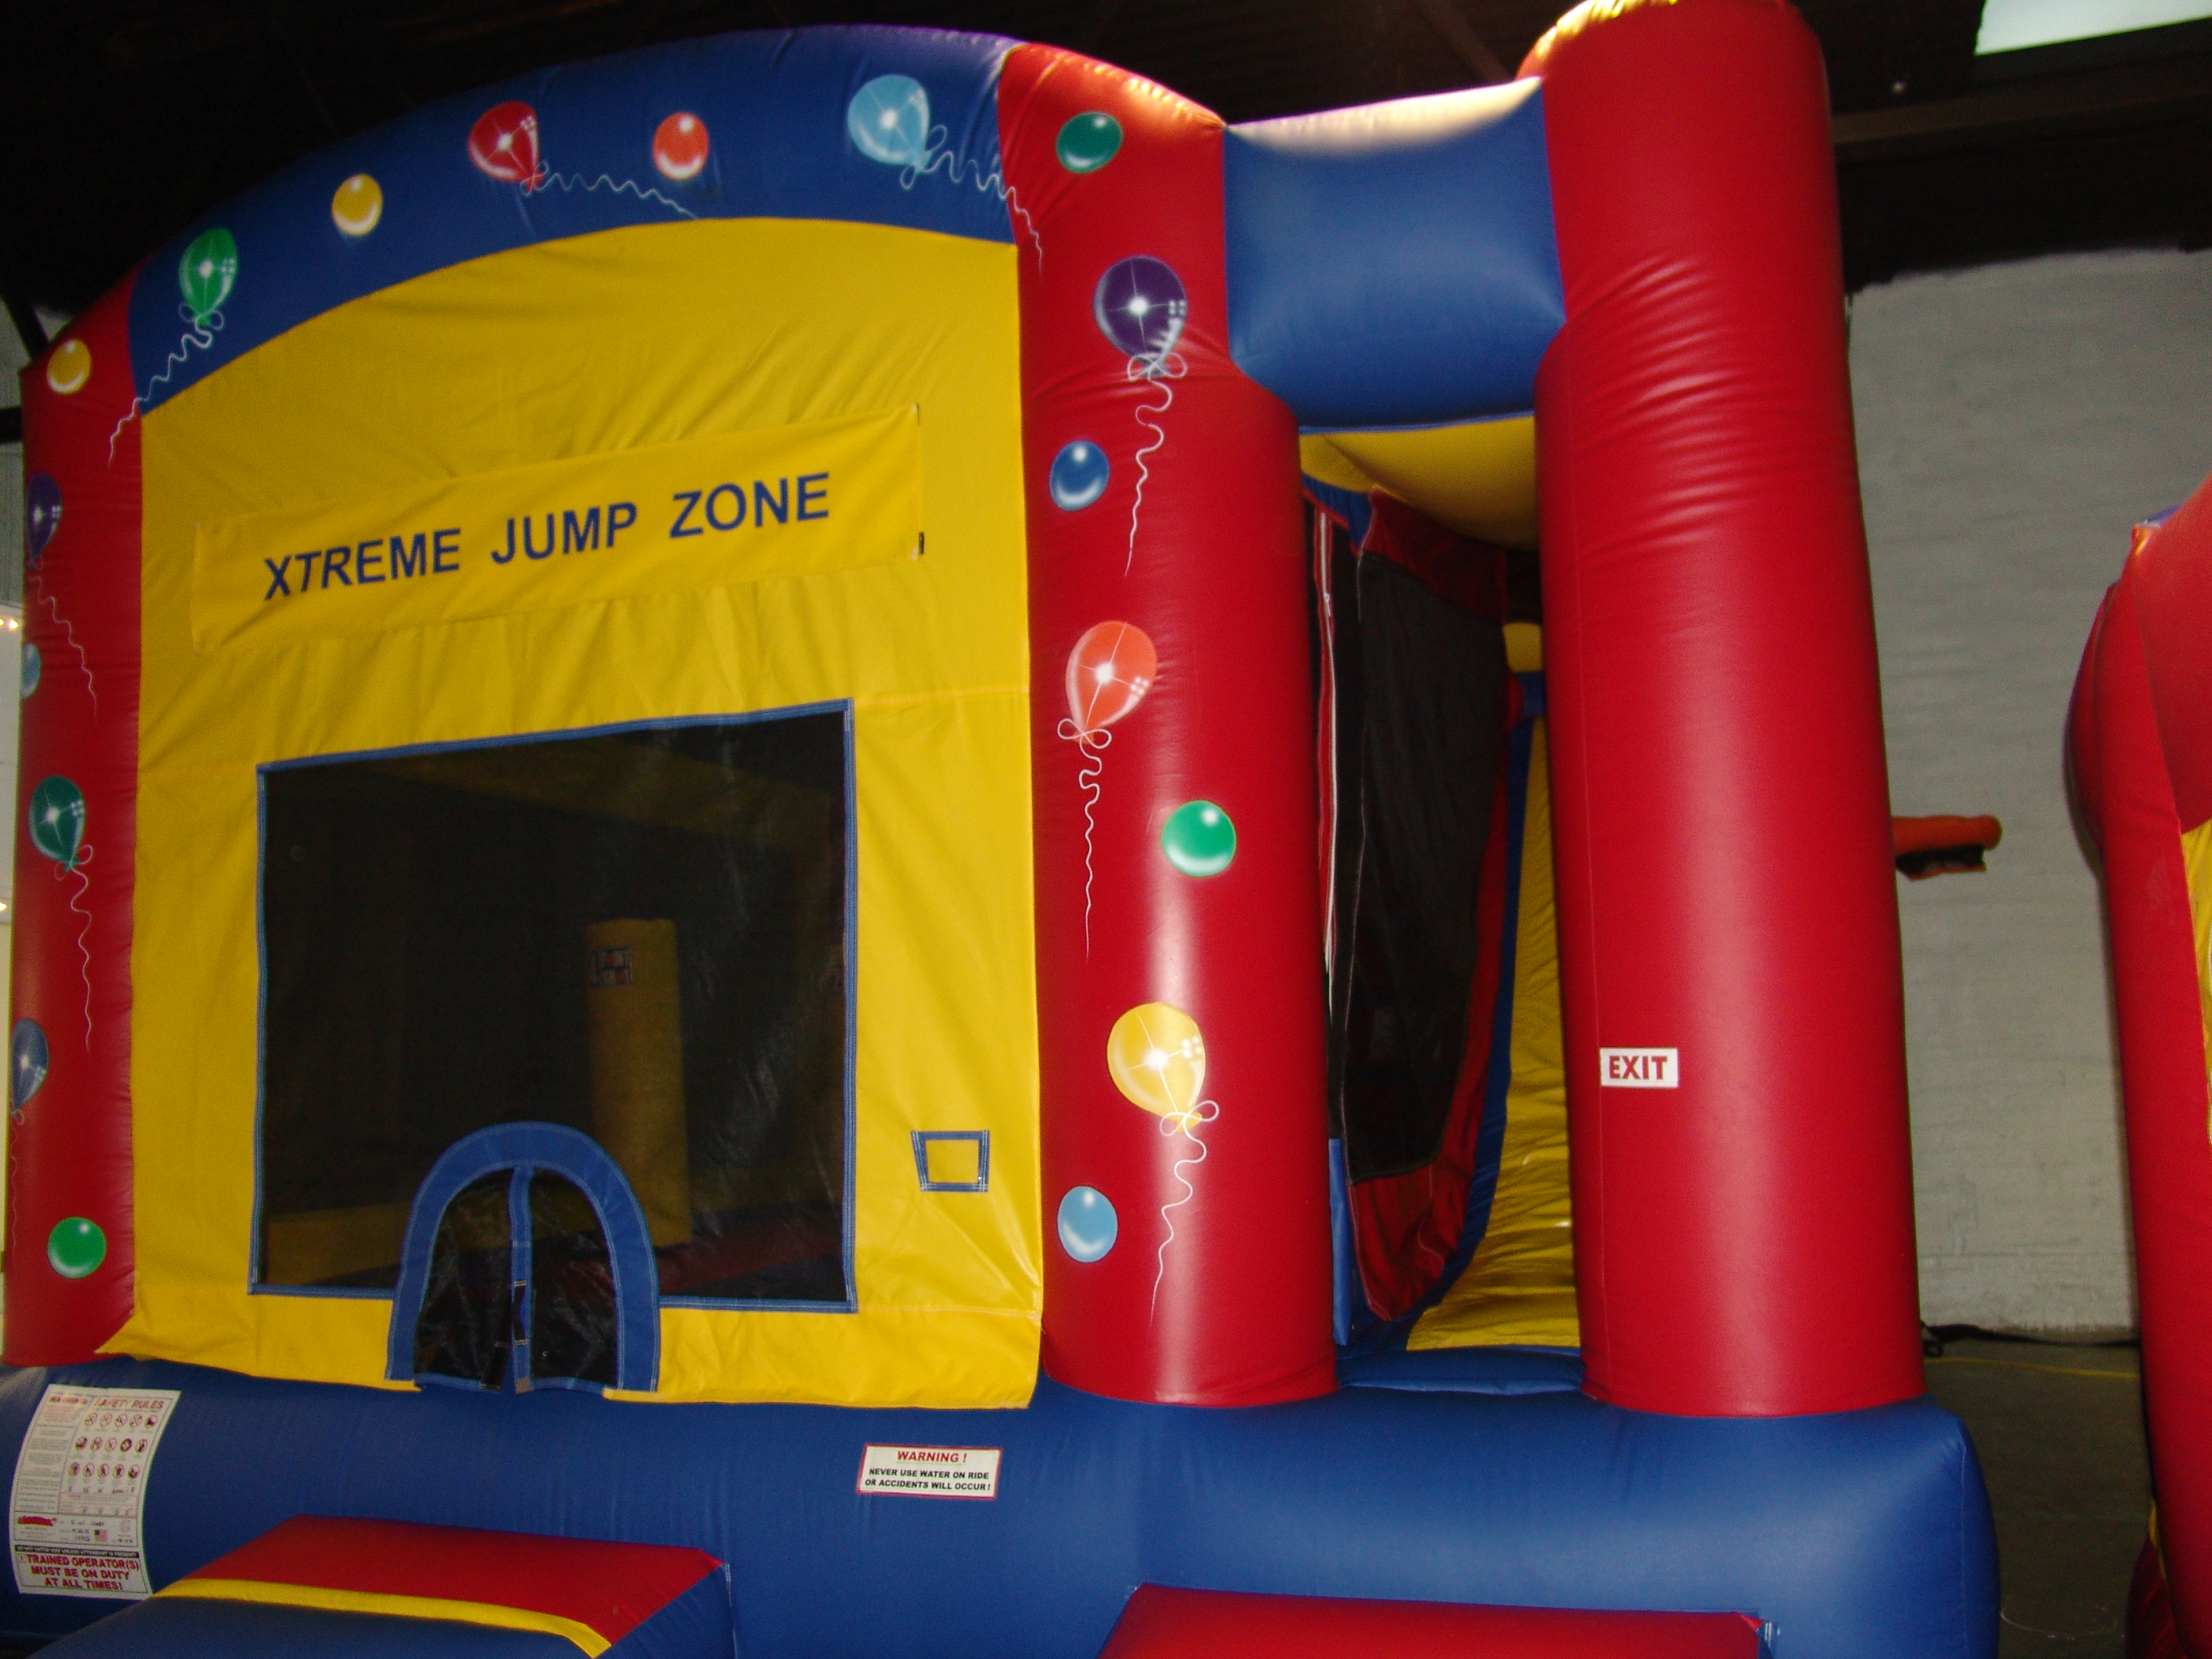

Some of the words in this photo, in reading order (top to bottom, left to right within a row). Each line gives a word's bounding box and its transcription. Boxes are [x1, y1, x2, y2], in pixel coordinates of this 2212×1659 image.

[264, 527, 461, 600] XTREME
[491, 501, 637, 565] JUMP
[670, 472, 830, 539] ZONE
[1609, 1055, 1668, 1080] EXIT
[131, 1399, 164, 1410] RULES
[897, 1450, 959, 1462] WARNING
[869, 1468, 898, 1476] NEVER
[920, 1470, 950, 1479] WATER
[878, 1479, 928, 1488] ACCIDENTS
[26, 1553, 69, 1565] TRAINED
[72, 1557, 140, 1571] OPERATOR(S)
[31, 1565, 61, 1576] MUST
[64, 1568, 78, 1577] BE
[81, 1569, 98, 1578] ON
[101, 1570, 129, 1580] DUTY
[45, 1578, 58, 1586] AT
[62, 1578, 82, 1589] ALL
[83, 1580, 123, 1591] TIMES!
